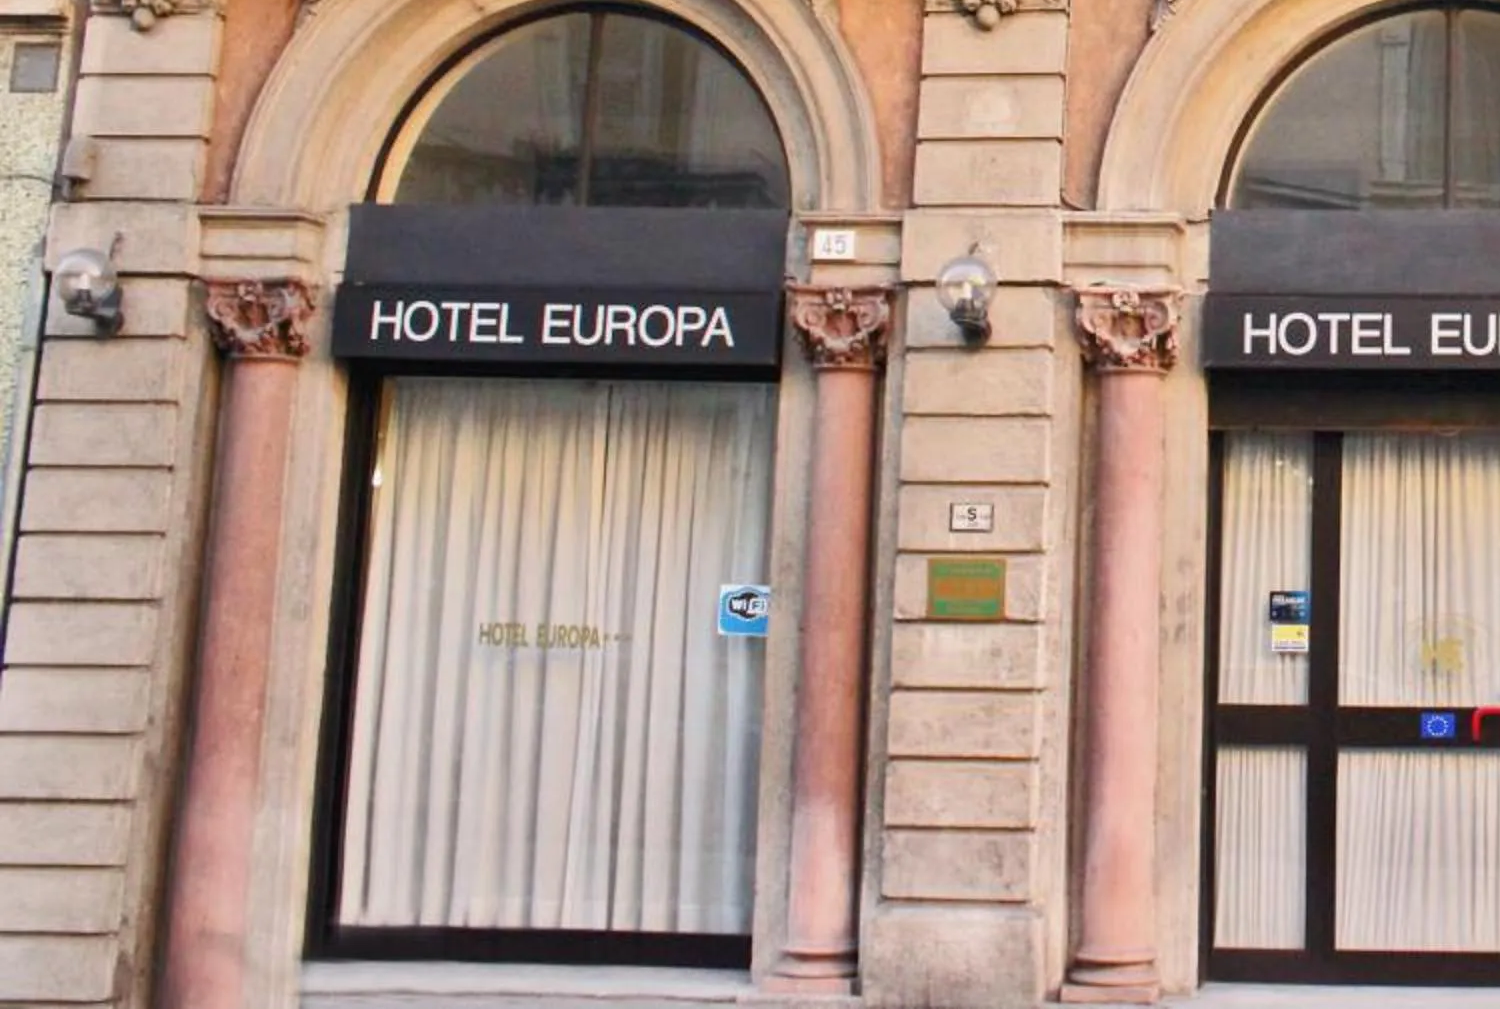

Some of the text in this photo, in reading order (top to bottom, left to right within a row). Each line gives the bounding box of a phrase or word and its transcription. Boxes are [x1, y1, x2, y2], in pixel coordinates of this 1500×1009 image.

[821, 233, 847, 256] 45
[370, 300, 735, 347] HOTEL EUROPA
[1243, 312, 1411, 356] HOTEL
[479, 622, 600, 650] HOTEL EUROPA
